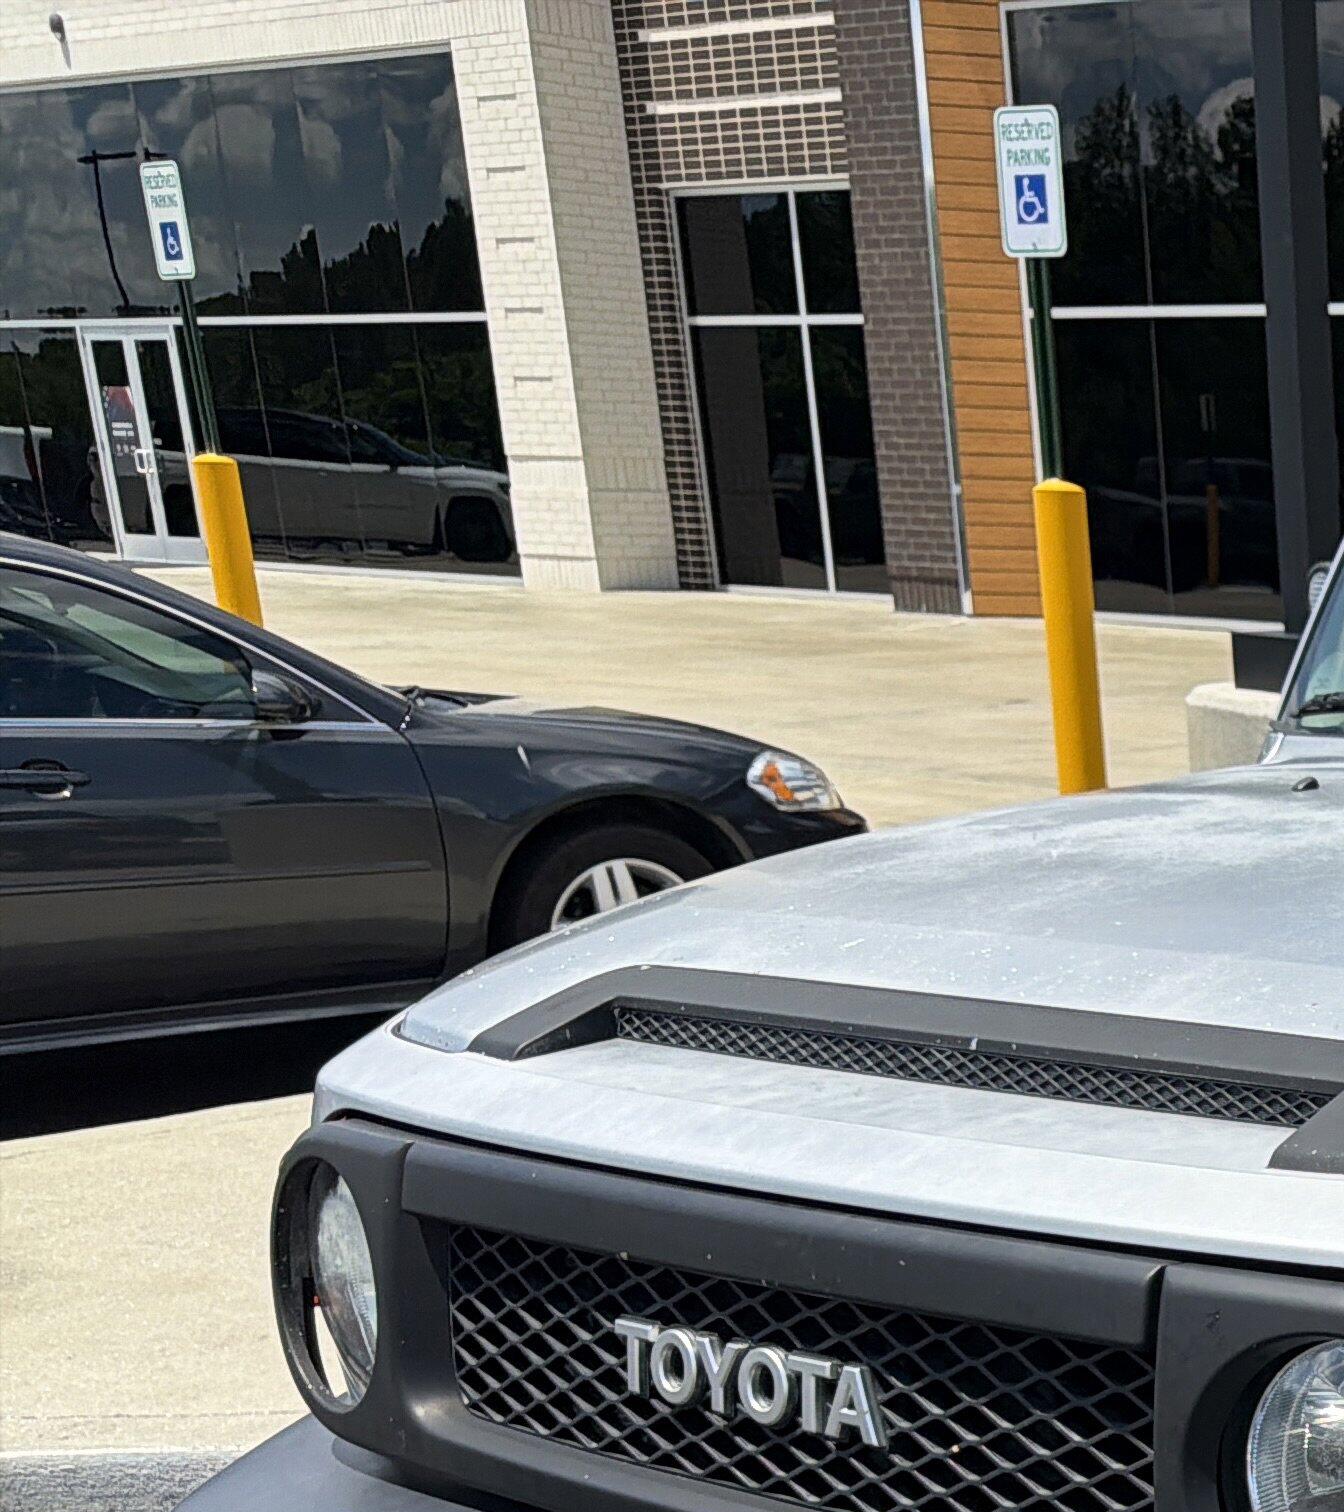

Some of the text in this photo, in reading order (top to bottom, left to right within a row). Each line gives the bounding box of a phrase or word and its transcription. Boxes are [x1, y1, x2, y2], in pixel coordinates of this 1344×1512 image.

[1001, 122, 1052, 141] RESERVED
[1007, 148, 1051, 167] PARKING
[613, 1314, 886, 1448] TOYOTA
